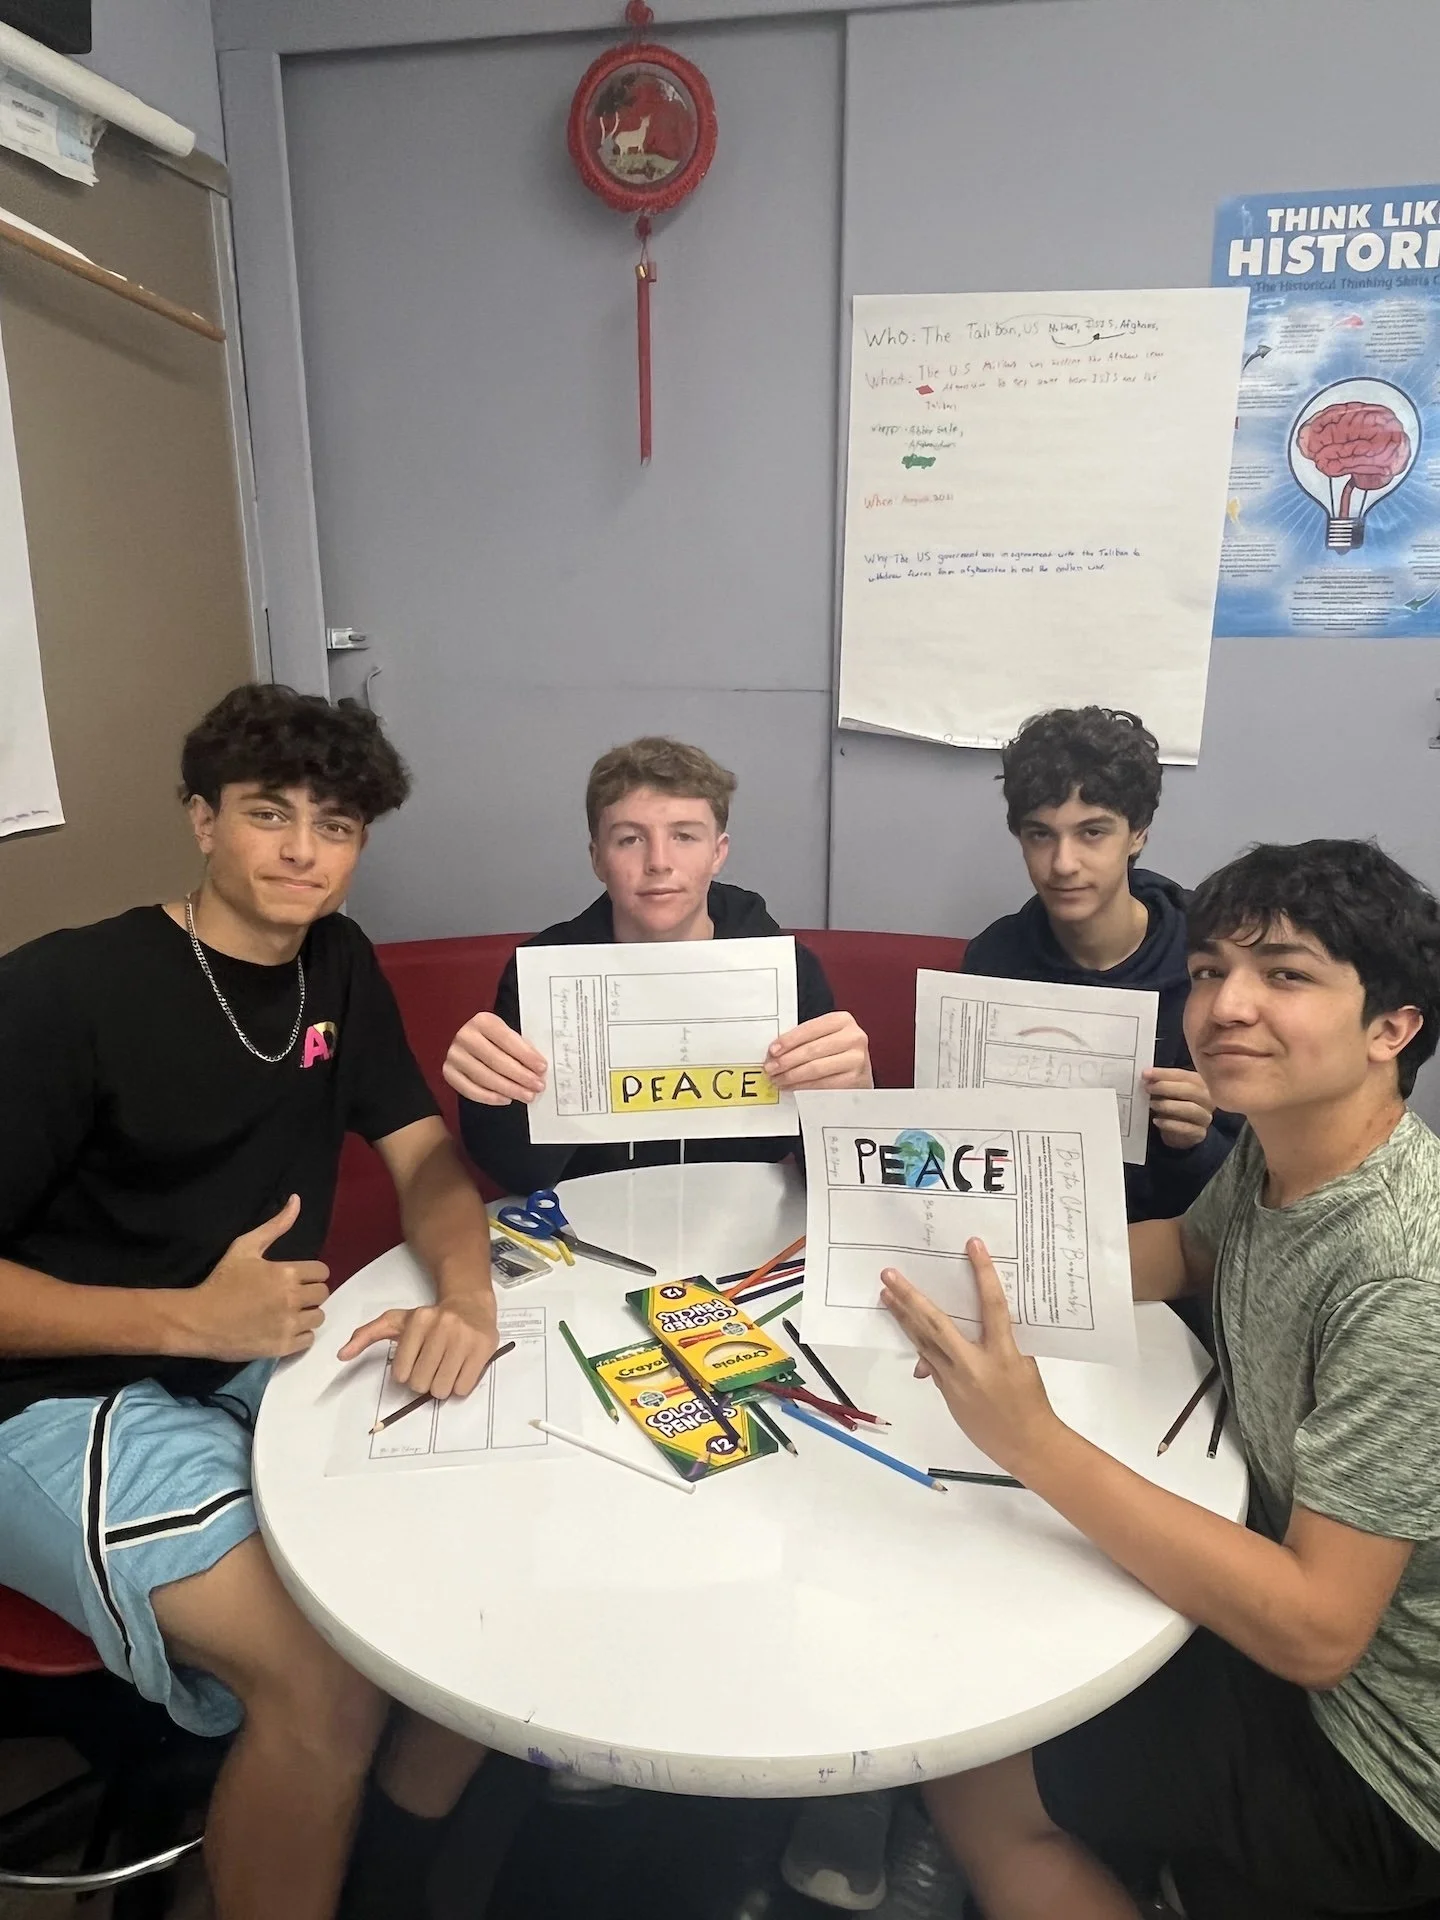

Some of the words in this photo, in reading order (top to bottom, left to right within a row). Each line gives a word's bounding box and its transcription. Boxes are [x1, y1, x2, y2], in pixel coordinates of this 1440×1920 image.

[1267, 203, 1372, 233] THINK
[1382, 200, 1440, 227] LIK
[1256, 281, 1277, 292] The
[1279, 277, 1336, 291] Historical
[1341, 276, 1393, 291] Thinking
[920, 325, 952, 345] The
[1023, 323, 1039, 335] US
[918, 364, 939, 381] The
[917, 552, 932, 563] US
[622, 1069, 764, 1104] PEACE
[854, 1138, 1010, 1192] PEACE
[1056, 1148, 1081, 1168] Be
[1057, 1171, 1081, 1190] the
[1056, 1196, 1083, 1241] Change
[1060, 1246, 1088, 1316] Bookmarks
[662, 1287, 684, 1299] 12
[656, 1299, 728, 1325] PENCILS
[662, 1307, 738, 1332] COLORED
[618, 1357, 668, 1377] Crayol
[712, 1350, 769, 1370] Crayola
[711, 1437, 735, 1453] 12
